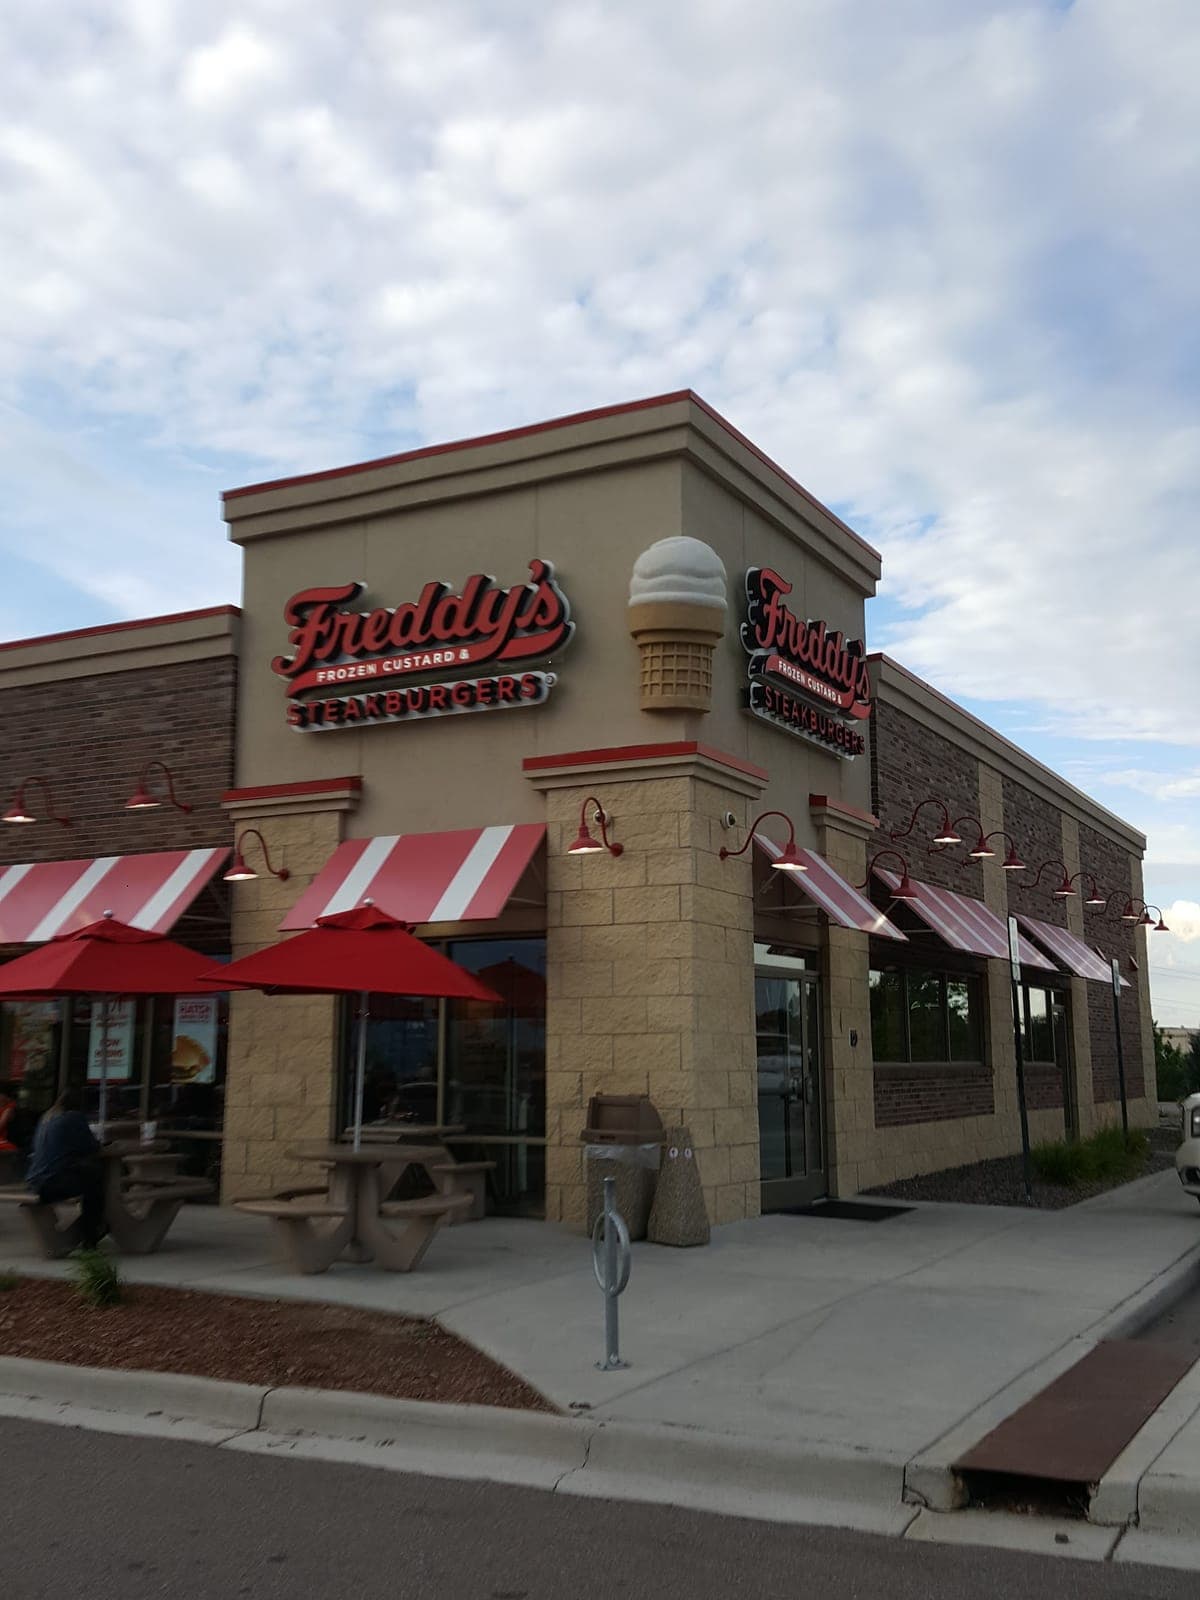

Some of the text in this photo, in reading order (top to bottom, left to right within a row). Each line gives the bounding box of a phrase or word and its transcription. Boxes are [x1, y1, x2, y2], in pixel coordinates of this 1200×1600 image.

[271, 559, 564, 678] Freddy's
[755, 567, 871, 708] Freddy's
[316, 648, 470, 683] FROZEN CUSTARD &
[778, 660, 806, 685] FROZEN
[807, 677, 837, 702] CUSTARD
[286, 673, 538, 726] STEAKBURGERS
